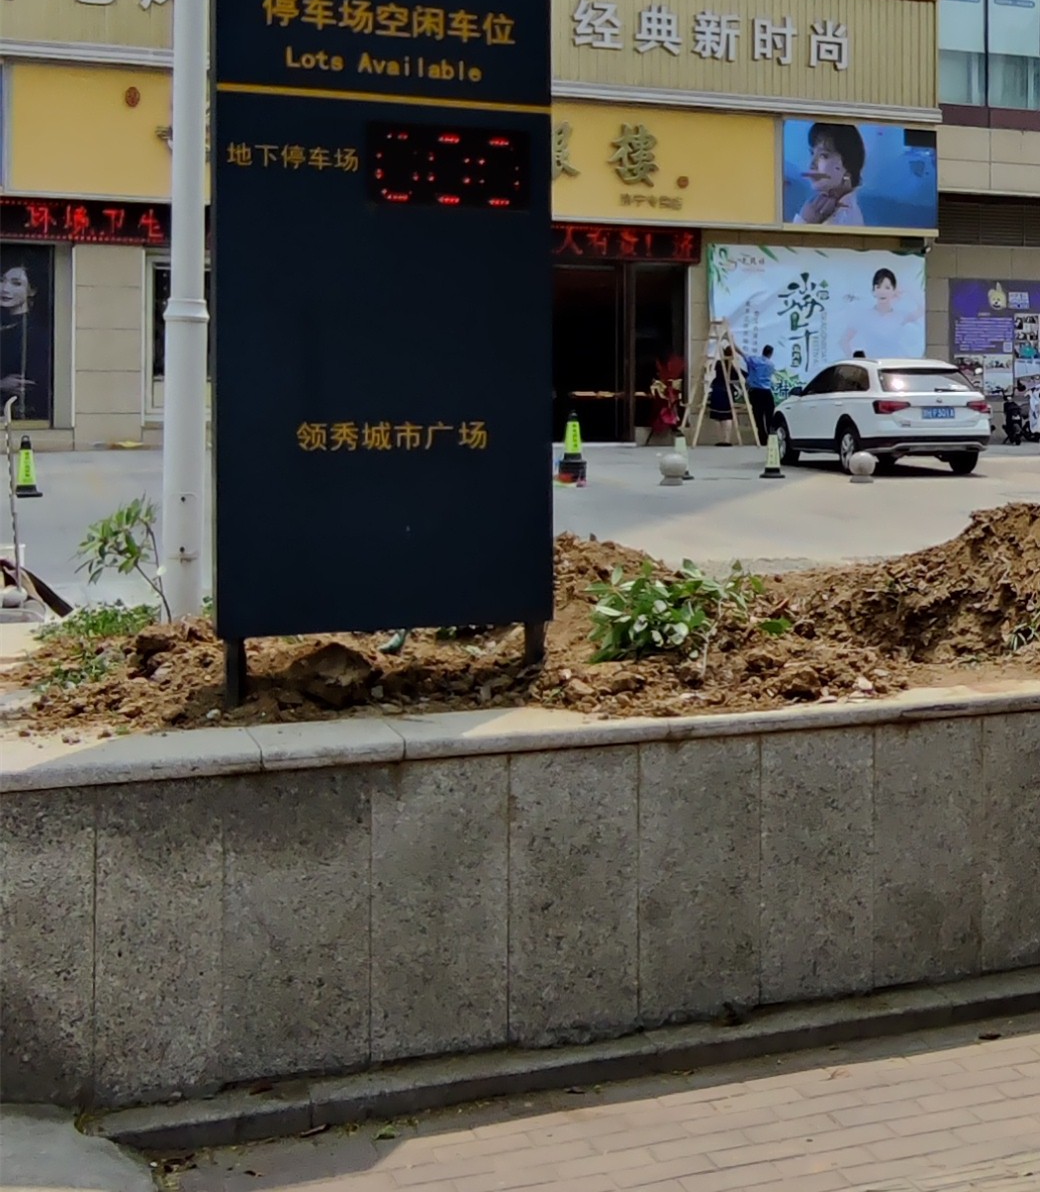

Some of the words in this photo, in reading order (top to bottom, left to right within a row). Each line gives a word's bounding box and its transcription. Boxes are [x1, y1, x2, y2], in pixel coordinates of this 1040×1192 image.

[284, 45, 344, 72] Lots
[357, 51, 483, 83] Available
[226, 141, 360, 173] 地下停车场
[296, 421, 489, 451] 领秀城市广场
